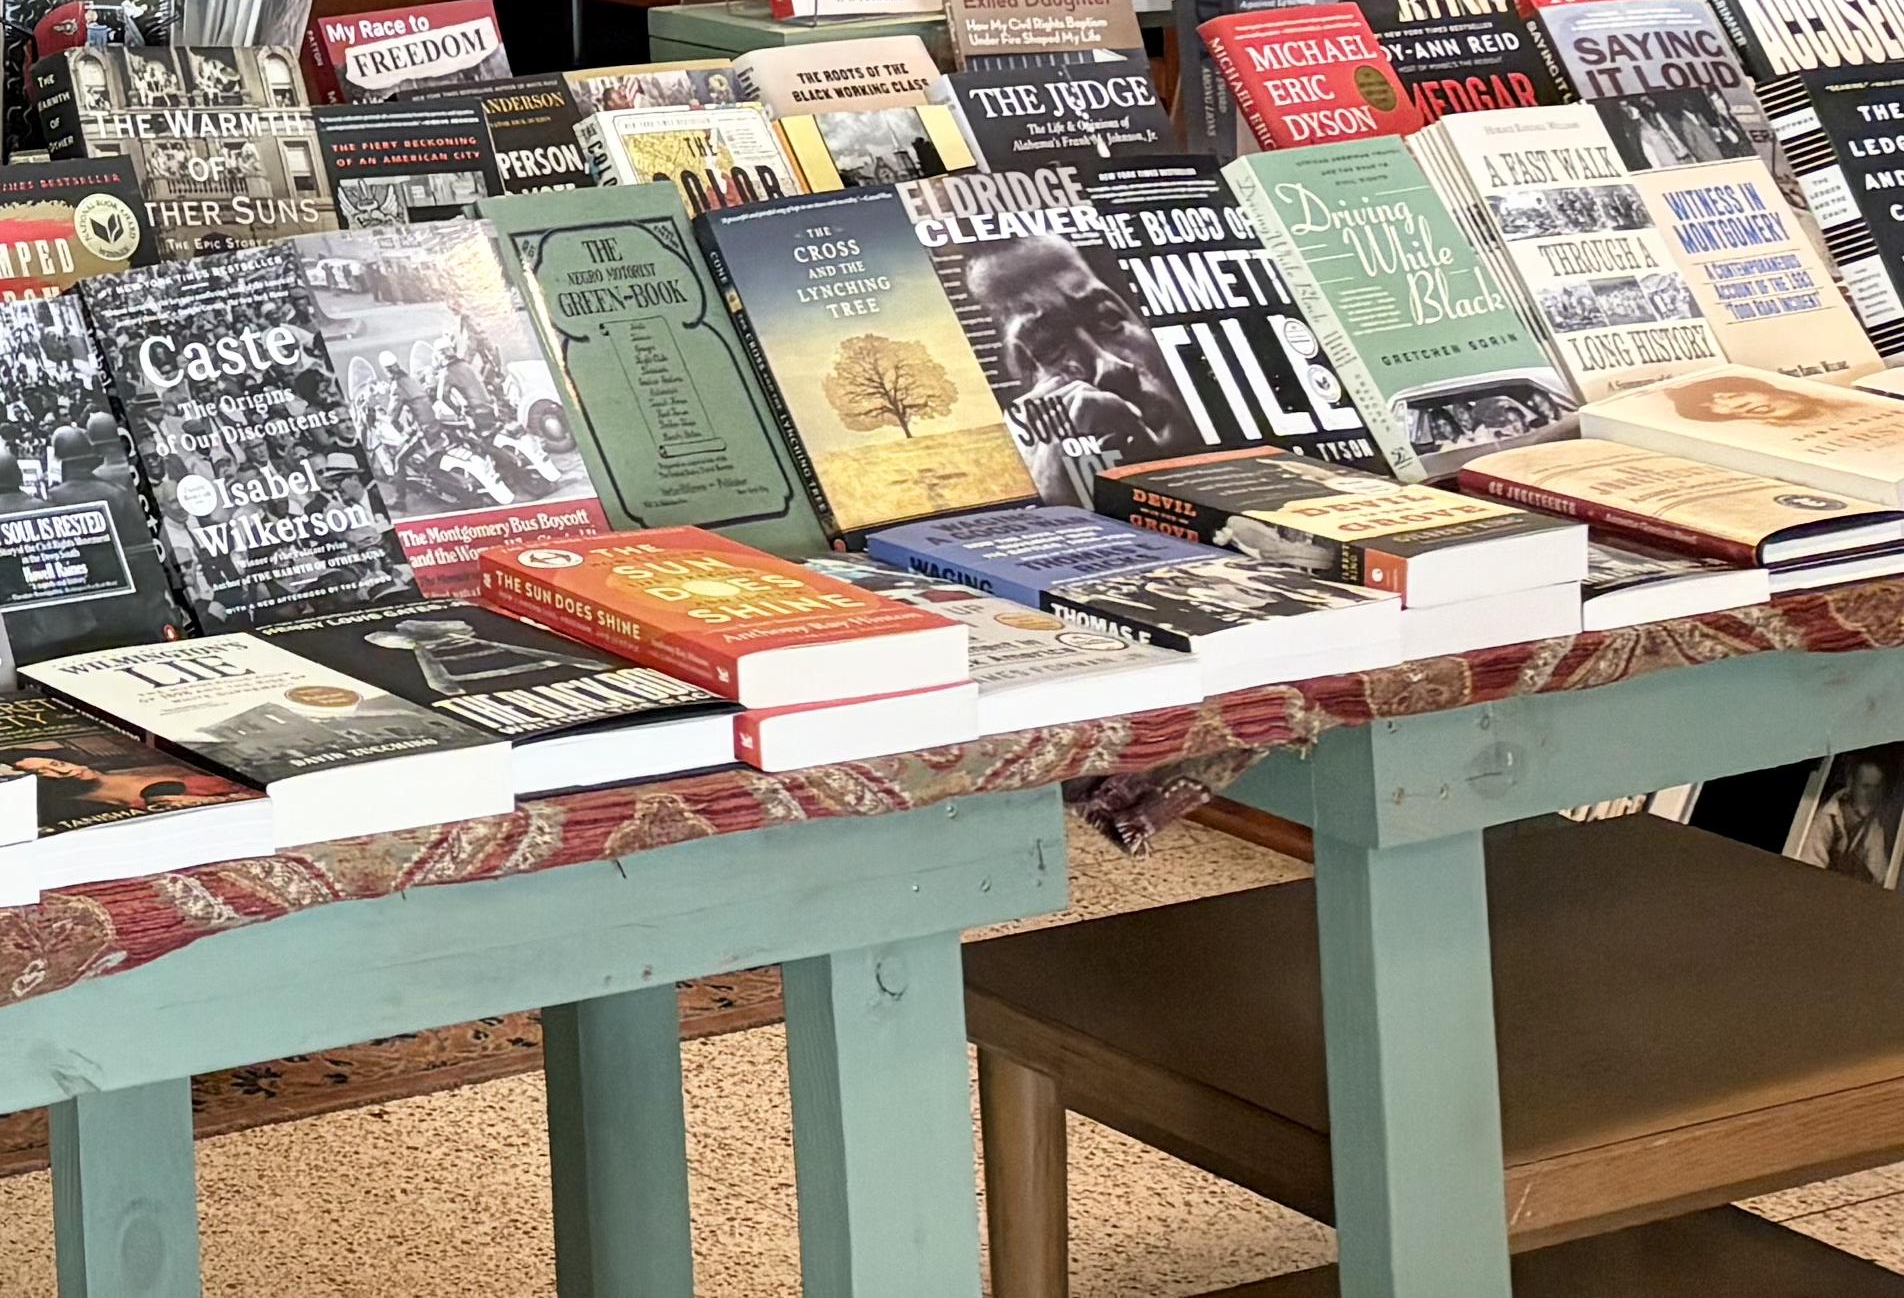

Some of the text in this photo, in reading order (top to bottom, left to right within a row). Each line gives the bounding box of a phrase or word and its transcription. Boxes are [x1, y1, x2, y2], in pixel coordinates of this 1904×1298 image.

[350, 28, 490, 80] FREEDOM
[1246, 35, 1379, 76] MICHAEL
[913, 204, 1106, 249] CLEAVER
[138, 323, 304, 390] Caste
